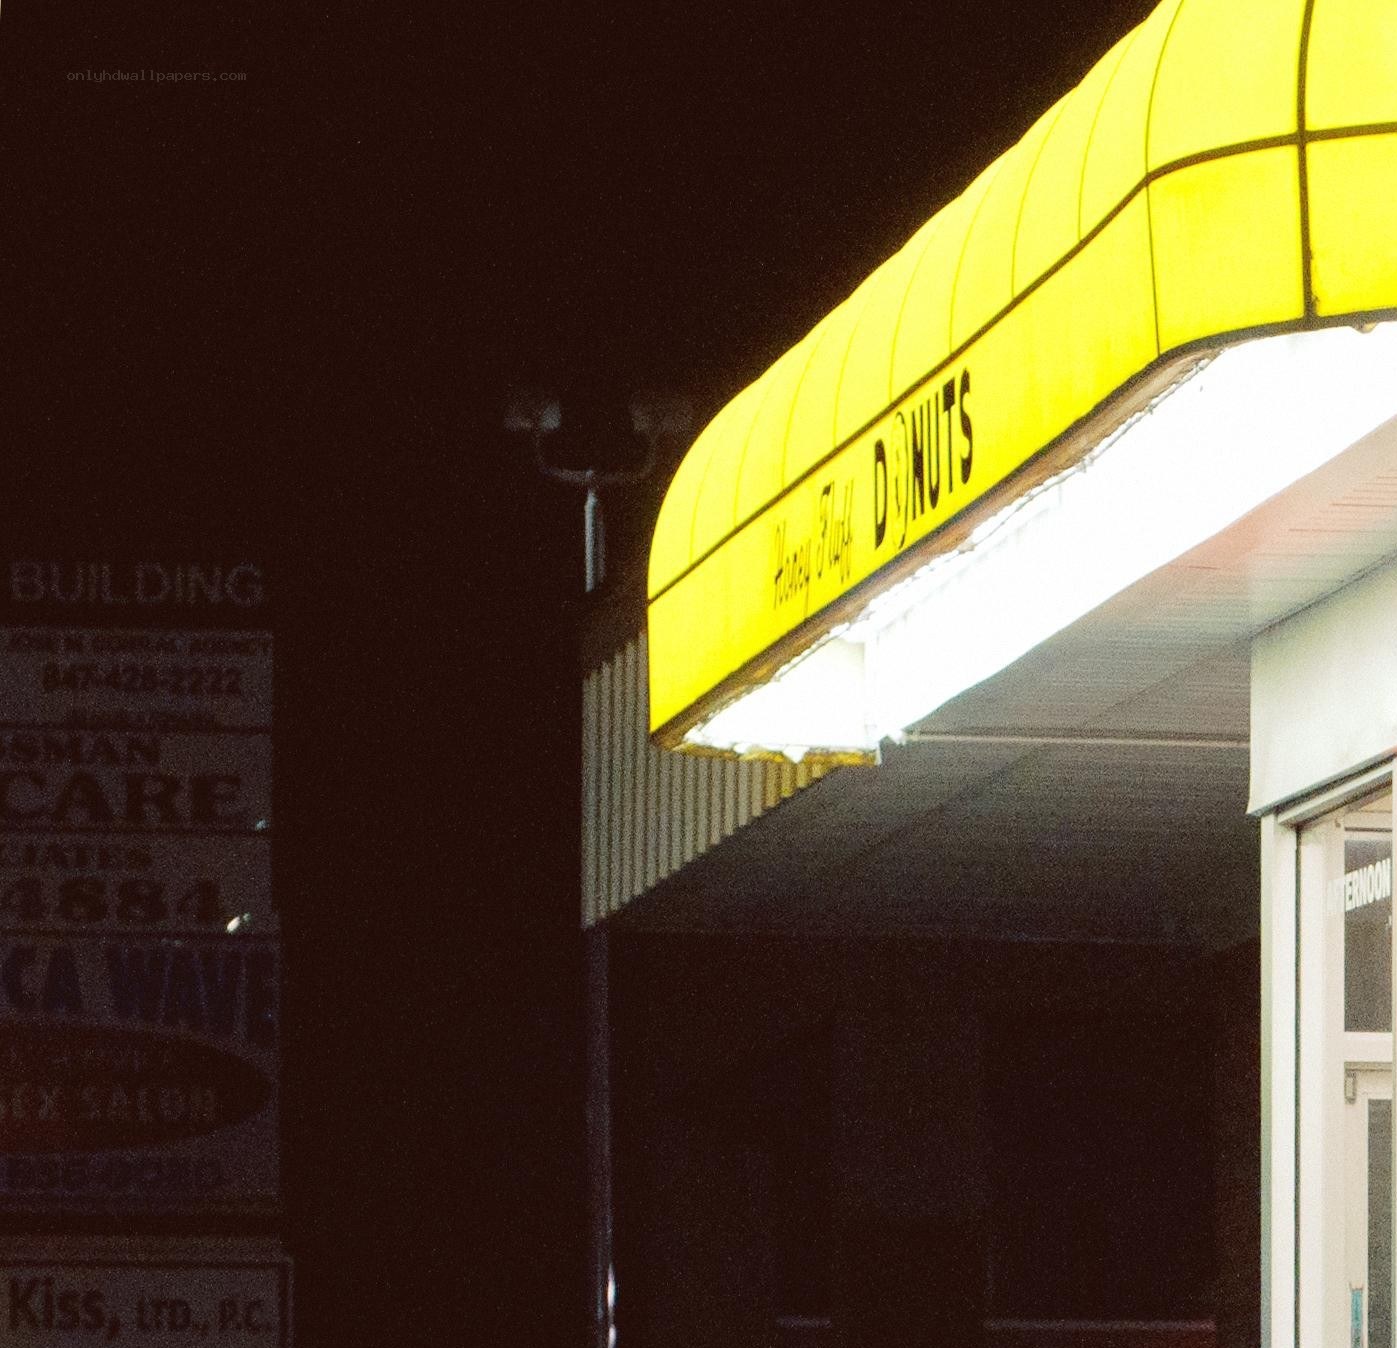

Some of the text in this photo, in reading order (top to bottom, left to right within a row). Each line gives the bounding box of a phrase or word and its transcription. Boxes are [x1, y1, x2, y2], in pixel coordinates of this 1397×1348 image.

[873, 367, 973, 550] DONUTS
[10, 561, 265, 607] BUILDING
[0, 768, 243, 823] CARE
[9, 1276, 120, 1341] Kiss,
